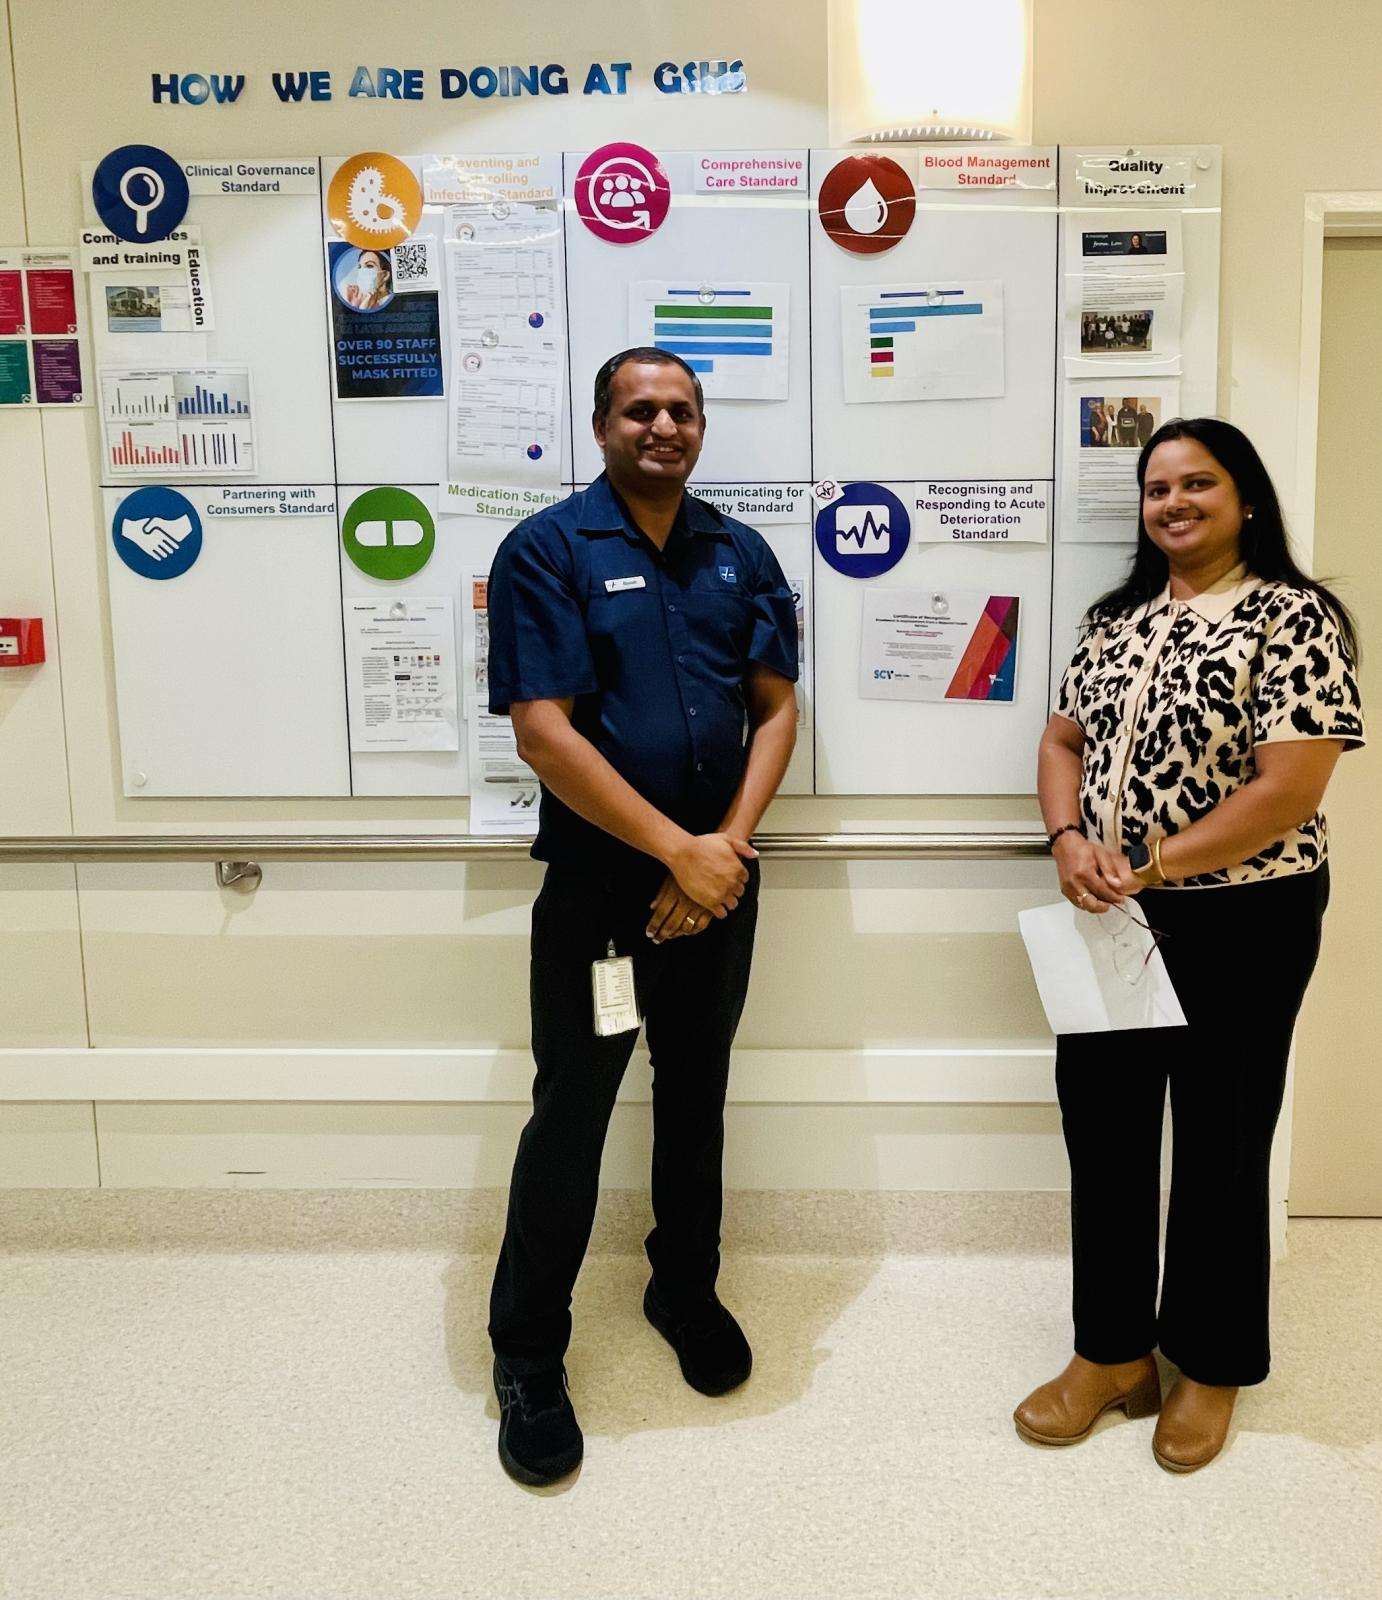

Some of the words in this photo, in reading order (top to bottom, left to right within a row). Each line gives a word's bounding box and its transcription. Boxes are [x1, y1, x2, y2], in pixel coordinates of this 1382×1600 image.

[152, 73, 245, 104] HOW
[272, 71, 332, 102] WE
[349, 66, 424, 99] ARE
[440, 63, 569, 98] DOING
[583, 62, 632, 96] AT
[443, 157, 513, 171] Peventing
[516, 157, 540, 167] and
[701, 159, 802, 171] Comprehensive
[925, 157, 962, 167] Blood
[968, 157, 1050, 170] Management
[1109, 161, 1163, 174] Quality
[185, 165, 232, 176] Clinical
[237, 164, 315, 176] Governance
[706, 176, 736, 187] Care
[739, 176, 798, 186] Standard
[958, 174, 1016, 185] Standard
[222, 181, 280, 192] Standard
[430, 189, 494, 201] Infectins
[497, 186, 553, 199] Standard
[93, 254, 119, 265] and
[124, 252, 181, 265] training
[187, 249, 204, 326] Education
[337, 341, 372, 350] OVER
[377, 340, 392, 350] 90
[396, 338, 436, 349] STAFF
[339, 354, 437, 365] SUCCESSFULLY
[352, 368, 390, 379] MASK
[393, 368, 438, 379] FITTED
[223, 490, 286, 501] Partnering
[290, 490, 315, 498] with
[448, 484, 519, 501] Medication
[686, 487, 783, 499] Communicating
[787, 487, 804, 497] for
[928, 484, 1006, 496] Recognising
[1011, 484, 1033, 494] and
[207, 505, 275, 515] Consumers
[279, 503, 335, 513] Standard
[476, 503, 535, 517] Standard
[737, 502, 794, 512] Standard
[916, 499, 990, 511] Responding
[994, 500, 1006, 509] to
[1009, 499, 1045, 509] Acute
[940, 514, 1021, 525] Deterioration
[952, 529, 1009, 539] Standard
